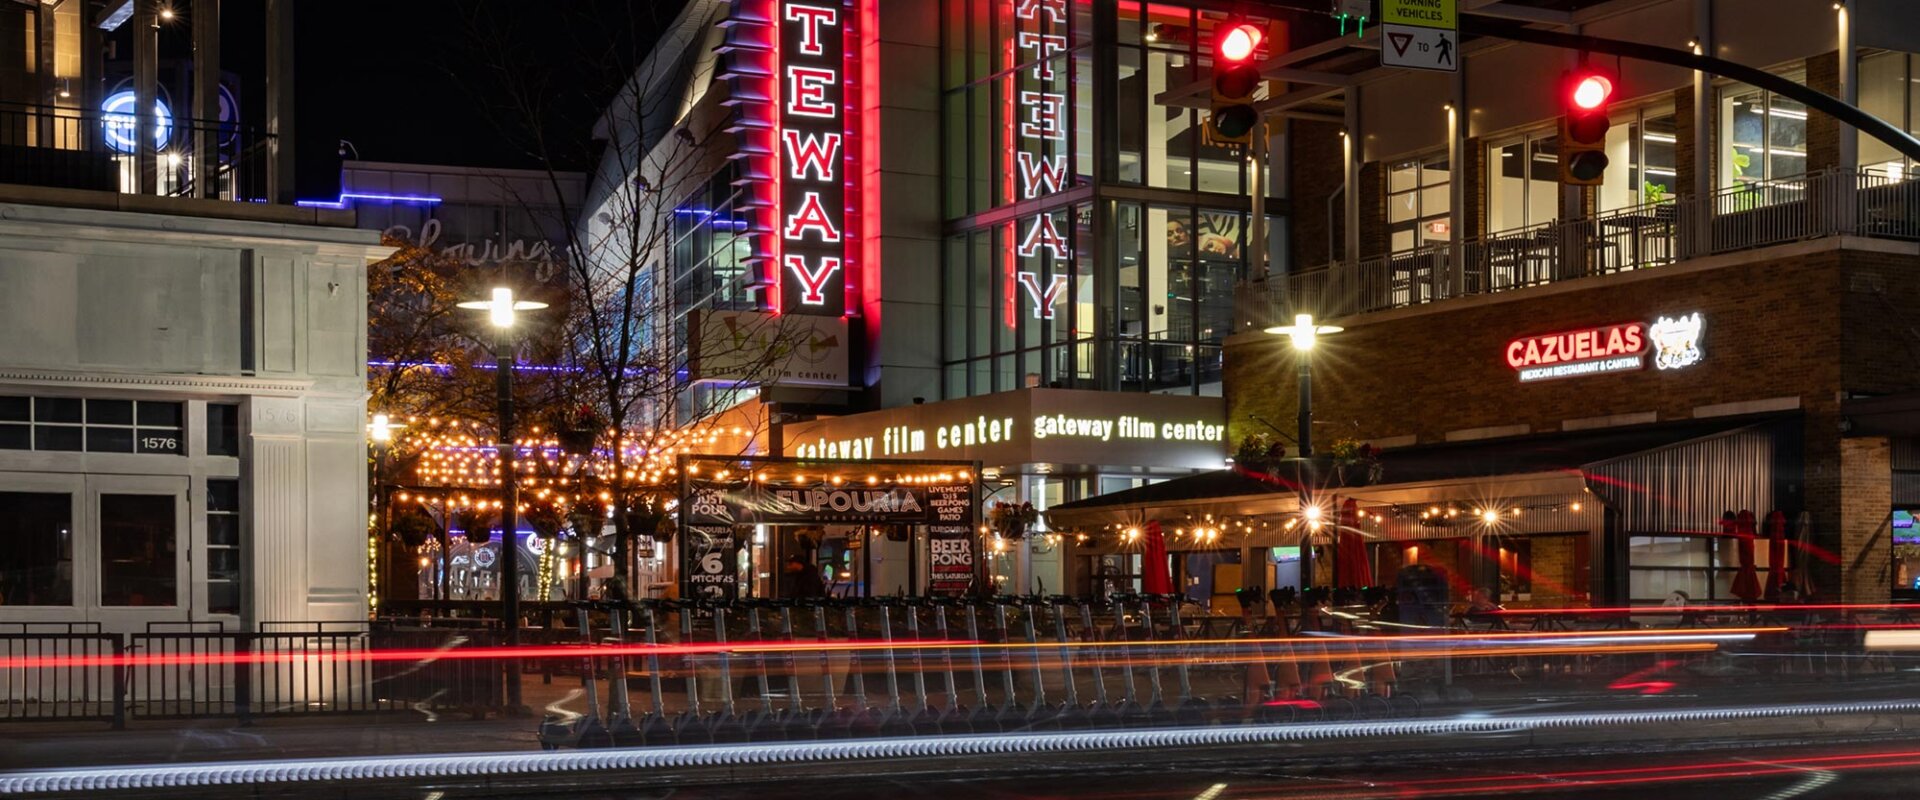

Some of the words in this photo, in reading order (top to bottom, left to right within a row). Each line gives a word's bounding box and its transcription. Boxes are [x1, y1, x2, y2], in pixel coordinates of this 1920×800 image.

[1396, 8, 1443, 20] VEHICLES
[1417, 42, 1430, 52] TO
[1507, 325, 1642, 367] CAZUELAS
[1521, 366, 1552, 380] MEXICAN
[1553, 363, 1600, 376] RESTAURANT
[1607, 357, 1640, 370] CANTINA
[798, 370, 838, 380] center
[1034, 414, 1113, 441] gateway
[1118, 416, 1155, 438] film
[1162, 421, 1224, 441] center
[796, 437, 873, 459] gateway
[883, 426, 925, 455] film
[937, 415, 1013, 449] center
[142, 438, 177, 449] 1576
[696, 494, 723, 505] JUST
[776, 490, 921, 513] EUPOURIA
[692, 505, 727, 515] POUR
[931, 539, 971, 554] BEER
[932, 553, 972, 565] PONG
